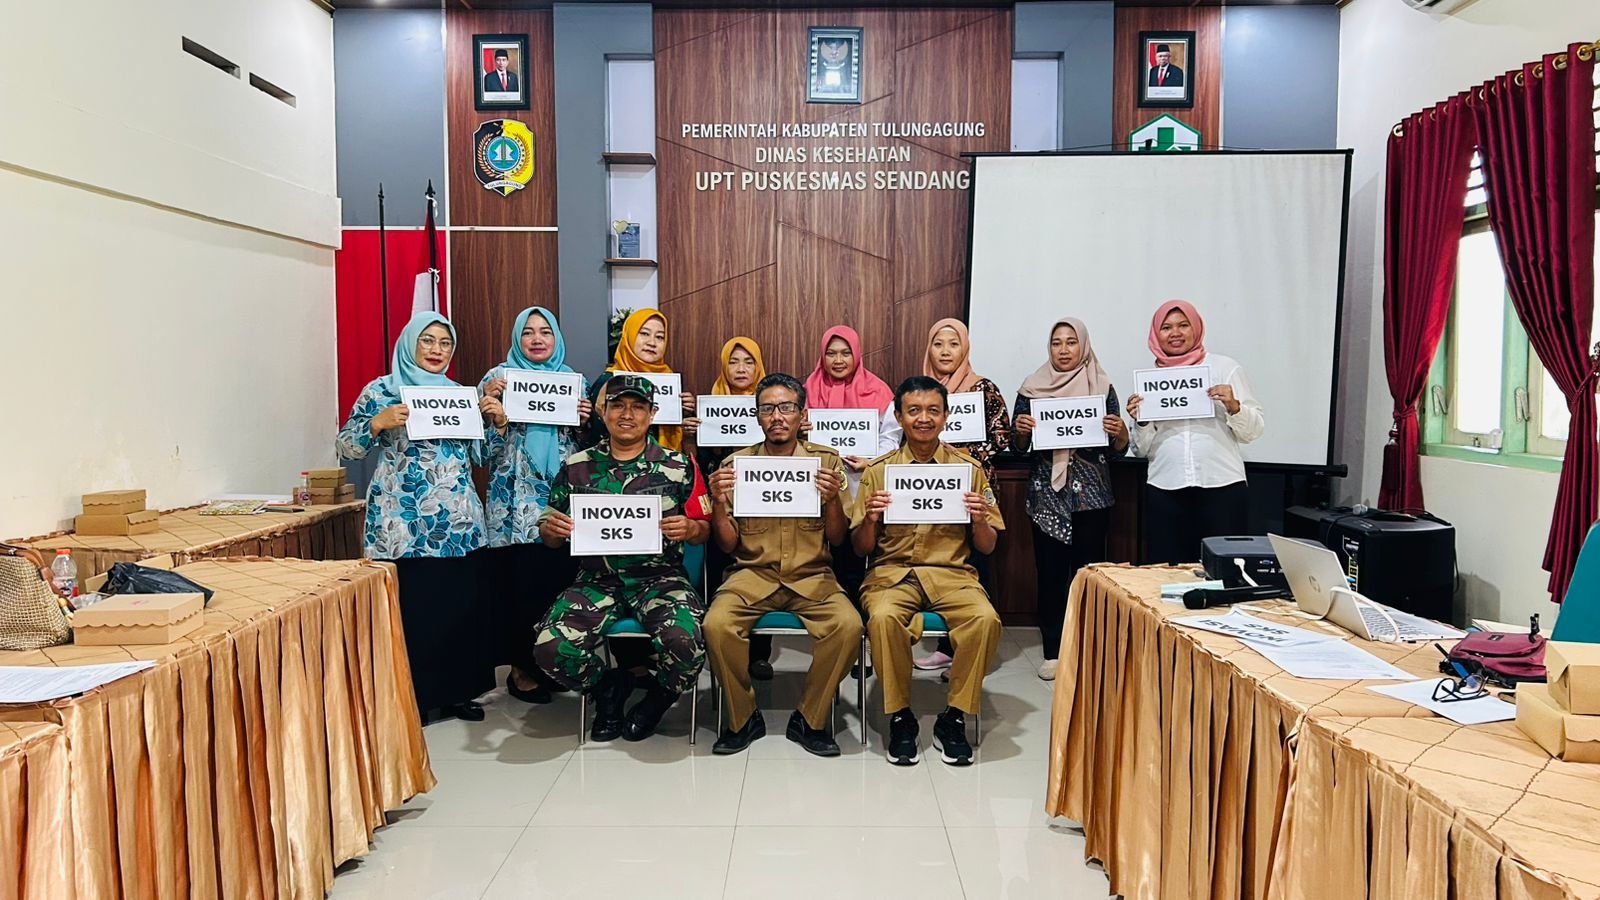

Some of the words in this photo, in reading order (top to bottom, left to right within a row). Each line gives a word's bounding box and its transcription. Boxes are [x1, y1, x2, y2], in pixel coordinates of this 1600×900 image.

[682, 123, 777, 138] PEMERINTAH
[781, 122, 868, 138] KABUPATEN
[872, 122, 986, 137] TULUNGAGUNG
[755, 147, 807, 163] DINAS
[812, 146, 912, 163] KESEHATAN
[695, 171, 736, 191] UPT
[741, 171, 868, 191] PUSKESMAS
[873, 170, 971, 191] SENDANG
[512, 381, 573, 396] INOVASI
[1143, 378, 1202, 393] INOVASI
[411, 397, 473, 410] INOVASI
[527, 400, 557, 412] SKS
[1160, 396, 1190, 408] SKS
[705, 407, 758, 418] INOVAS
[1040, 408, 1098, 421] INOVASI
[432, 415, 461, 426] SKS
[816, 420, 871, 431] INOVASI
[945, 421, 962, 432] KS
[720, 424, 747, 435] SKS
[1056, 425, 1084, 437] SKS
[830, 436, 857, 447] SKS
[744, 470, 811, 483] INOVASI
[895, 478, 961, 491] INOVASI
[761, 490, 793, 503] SKS
[912, 498, 943, 510] SKS
[582, 507, 652, 520] INOVASI
[600, 527, 633, 540] SKS
[1198, 619, 1289, 643] INOVASI
[1243, 622, 1290, 635] SKS
